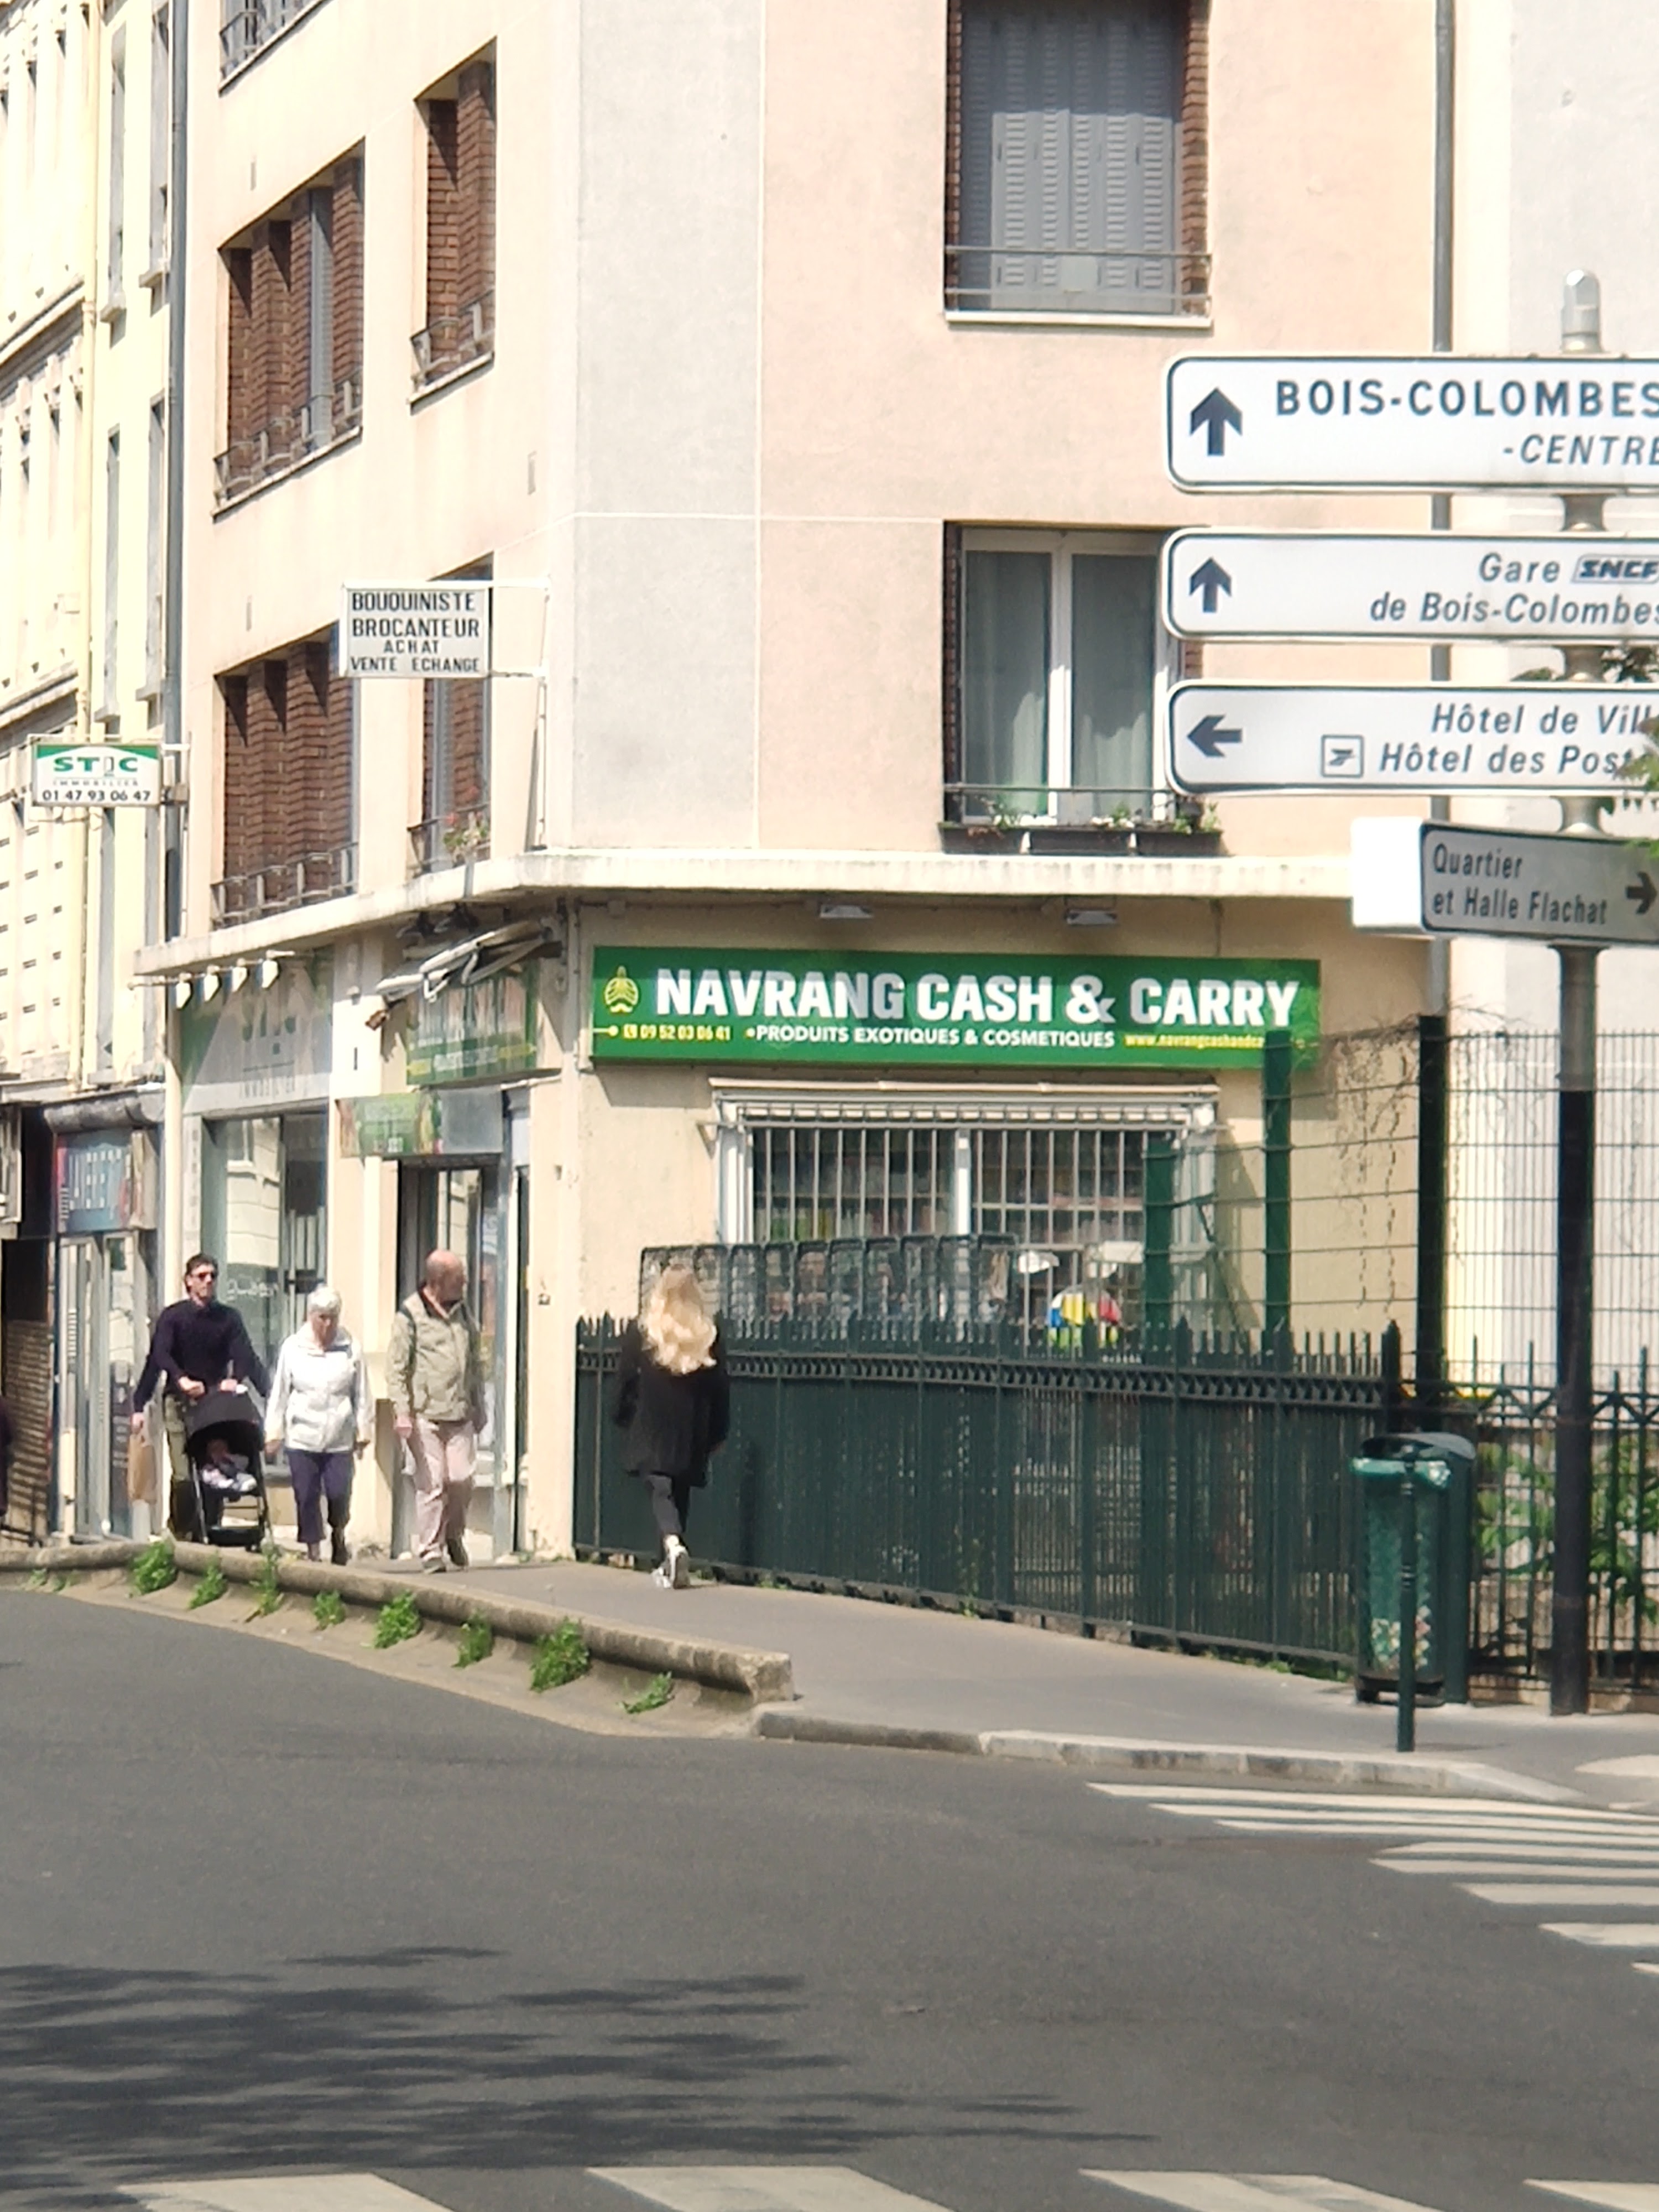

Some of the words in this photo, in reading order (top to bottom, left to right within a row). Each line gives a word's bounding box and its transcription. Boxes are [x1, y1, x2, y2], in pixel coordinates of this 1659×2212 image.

[1276, 379, 1659, 418] BOIS-COLOMBES
[1480, 554, 1560, 583] Gare
[1580, 560, 1659, 578] SNCF
[1371, 593, 1405, 622] de
[352, 618, 479, 638] BROCANTEUR
[384, 639, 440, 654] ACHAT
[351, 657, 397, 671] VENTE
[411, 658, 479, 672] ECHANGE
[1432, 703, 1524, 734] Hôtel
[1540, 705, 1578, 734] de
[1598, 705, 1651, 734] Vil
[1380, 743, 1471, 773] Hôtel
[1488, 744, 1545, 774] des
[42, 790, 59, 801] 01
[65, 790, 82, 801] 47
[87, 790, 105, 801] 93
[110, 790, 128, 801] 06
[133, 791, 151, 801] 47
[1433, 844, 1522, 879] Quartier
[1433, 891, 1453, 916] et
[1464, 890, 1518, 920] Halle
[1529, 891, 1607, 925] Flachat
[656, 968, 905, 1020] NAVRANG
[916, 973, 1052, 1022] CASH
[1065, 975, 1115, 1024] &
[1129, 978, 1300, 1027] CARRY
[757, 1026, 849, 1043] PRODUITS
[854, 1027, 960, 1046] EXOTIQUES
[963, 1030, 978, 1045] &
[983, 1030, 1115, 1048] COSMETIQUES
